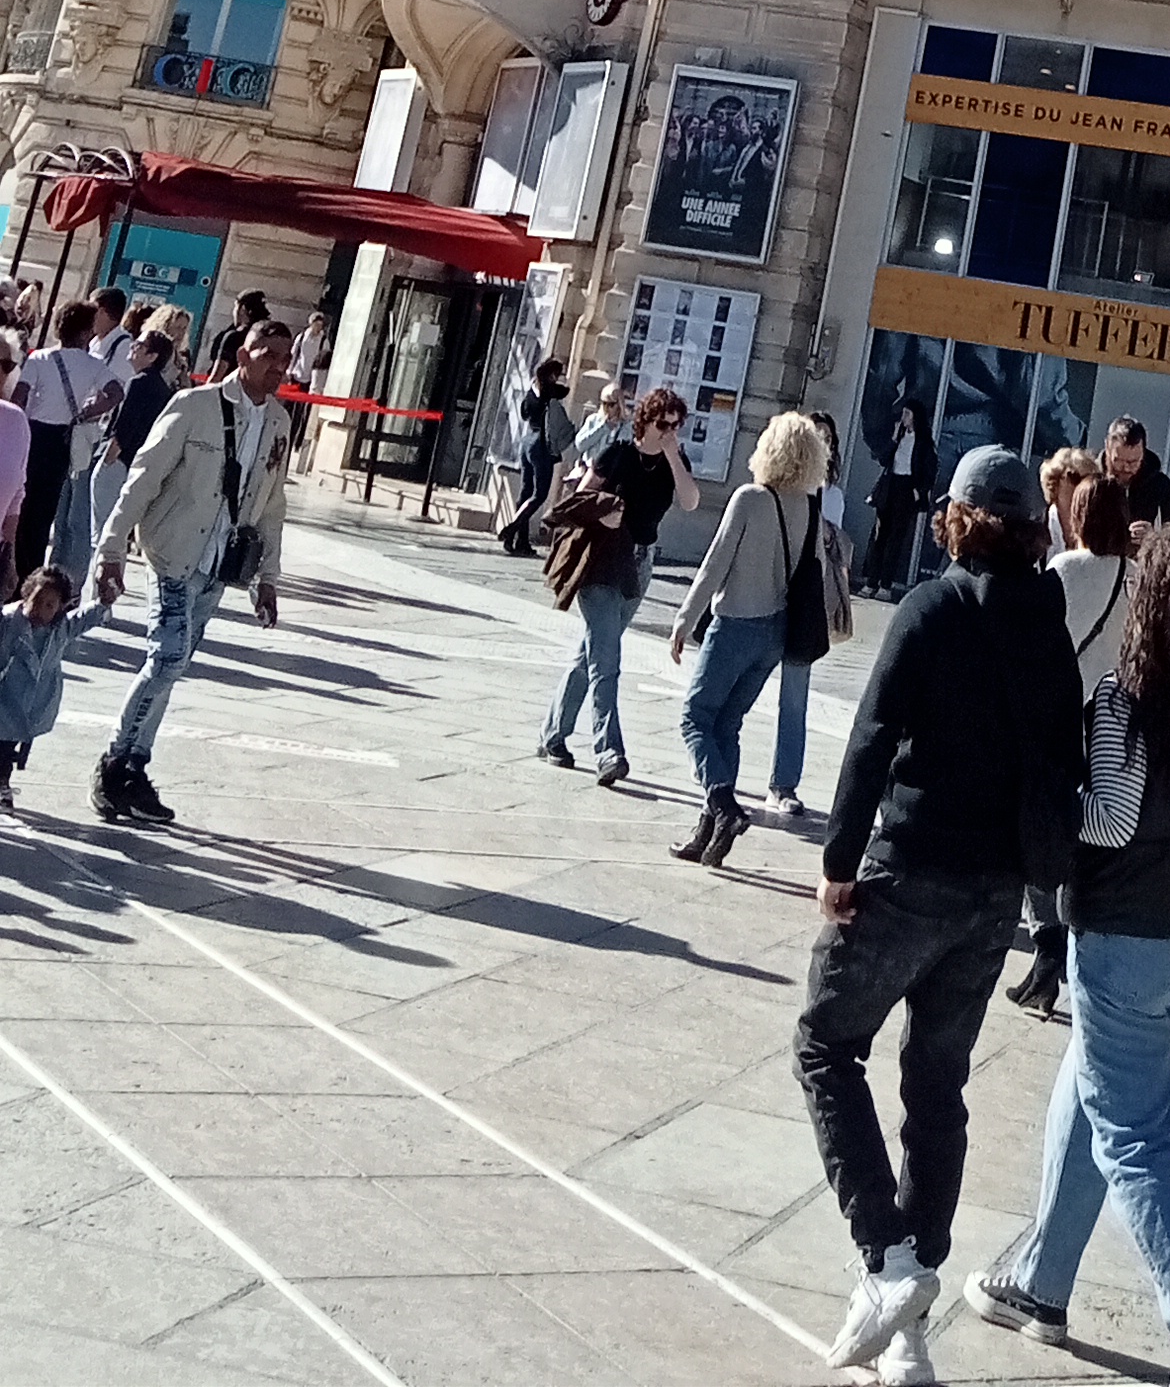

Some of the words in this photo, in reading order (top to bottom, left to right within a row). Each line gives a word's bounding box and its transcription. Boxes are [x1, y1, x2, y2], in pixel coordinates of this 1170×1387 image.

[915, 90, 1026, 118] EXPERTISE
[1034, 106, 1062, 123] DU
[1070, 111, 1123, 132] JEAN
[681, 196, 705, 210] UNE
[685, 209, 733, 229] DIFFICILE
[1094, 300, 1139, 318] Atelier
